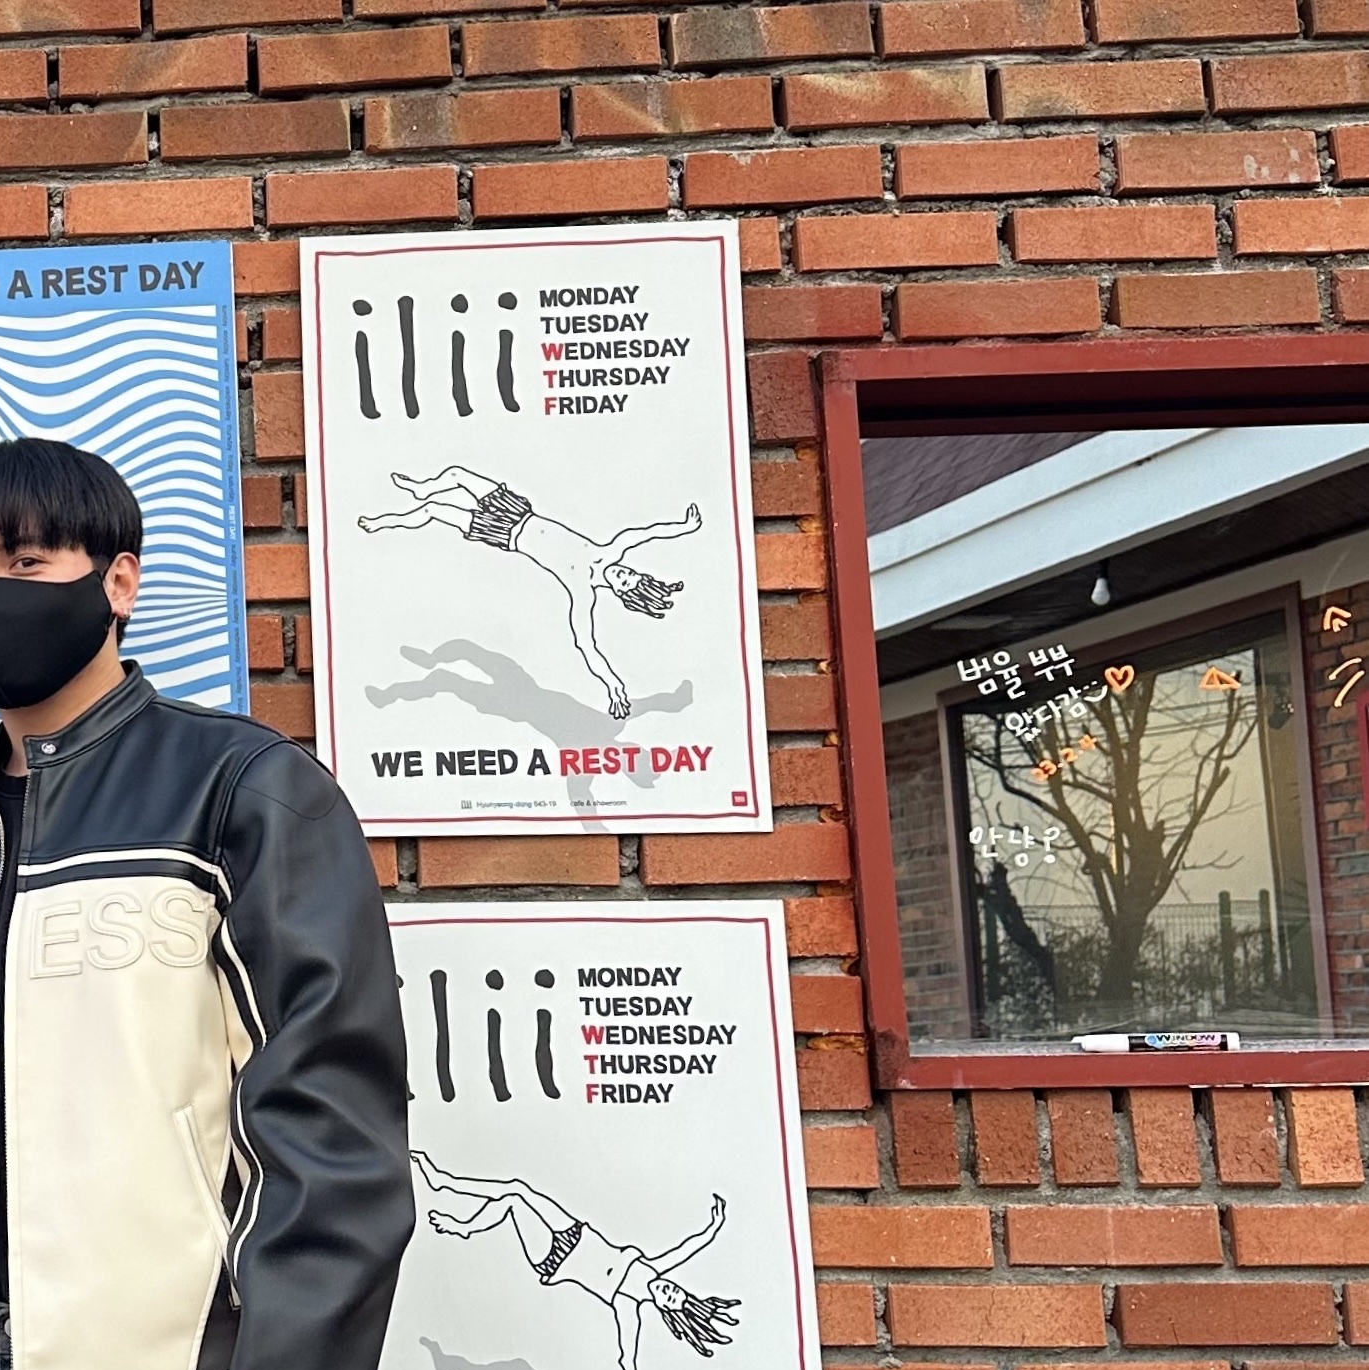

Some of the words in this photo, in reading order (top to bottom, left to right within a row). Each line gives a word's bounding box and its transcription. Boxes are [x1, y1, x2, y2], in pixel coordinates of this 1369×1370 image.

[8, 270, 32, 299] A
[42, 265, 127, 298] REST
[139, 261, 204, 291] DAY
[540, 286, 639, 307] MONDAY
[541, 313, 648, 334] TUESDAY
[542, 338, 689, 361] WEDNESDAY
[543, 367, 670, 388] THURSDAY
[545, 395, 628, 415] FRIDAY
[371, 751, 423, 777] WE
[436, 750, 518, 776] NEED
[528, 749, 551, 776] A
[560, 748, 640, 776] REST
[651, 746, 712, 772] DAY
[29, 885, 209, 979] ESS
[578, 967, 681, 987] MONDAY
[580, 996, 692, 1016] TUESDAY
[582, 1025, 736, 1045] WEDNESDAY
[1156, 1034, 1215, 1042] WINDOW
[584, 1054, 716, 1074] THURSDAY
[587, 1084, 673, 1103] FRIDAY
